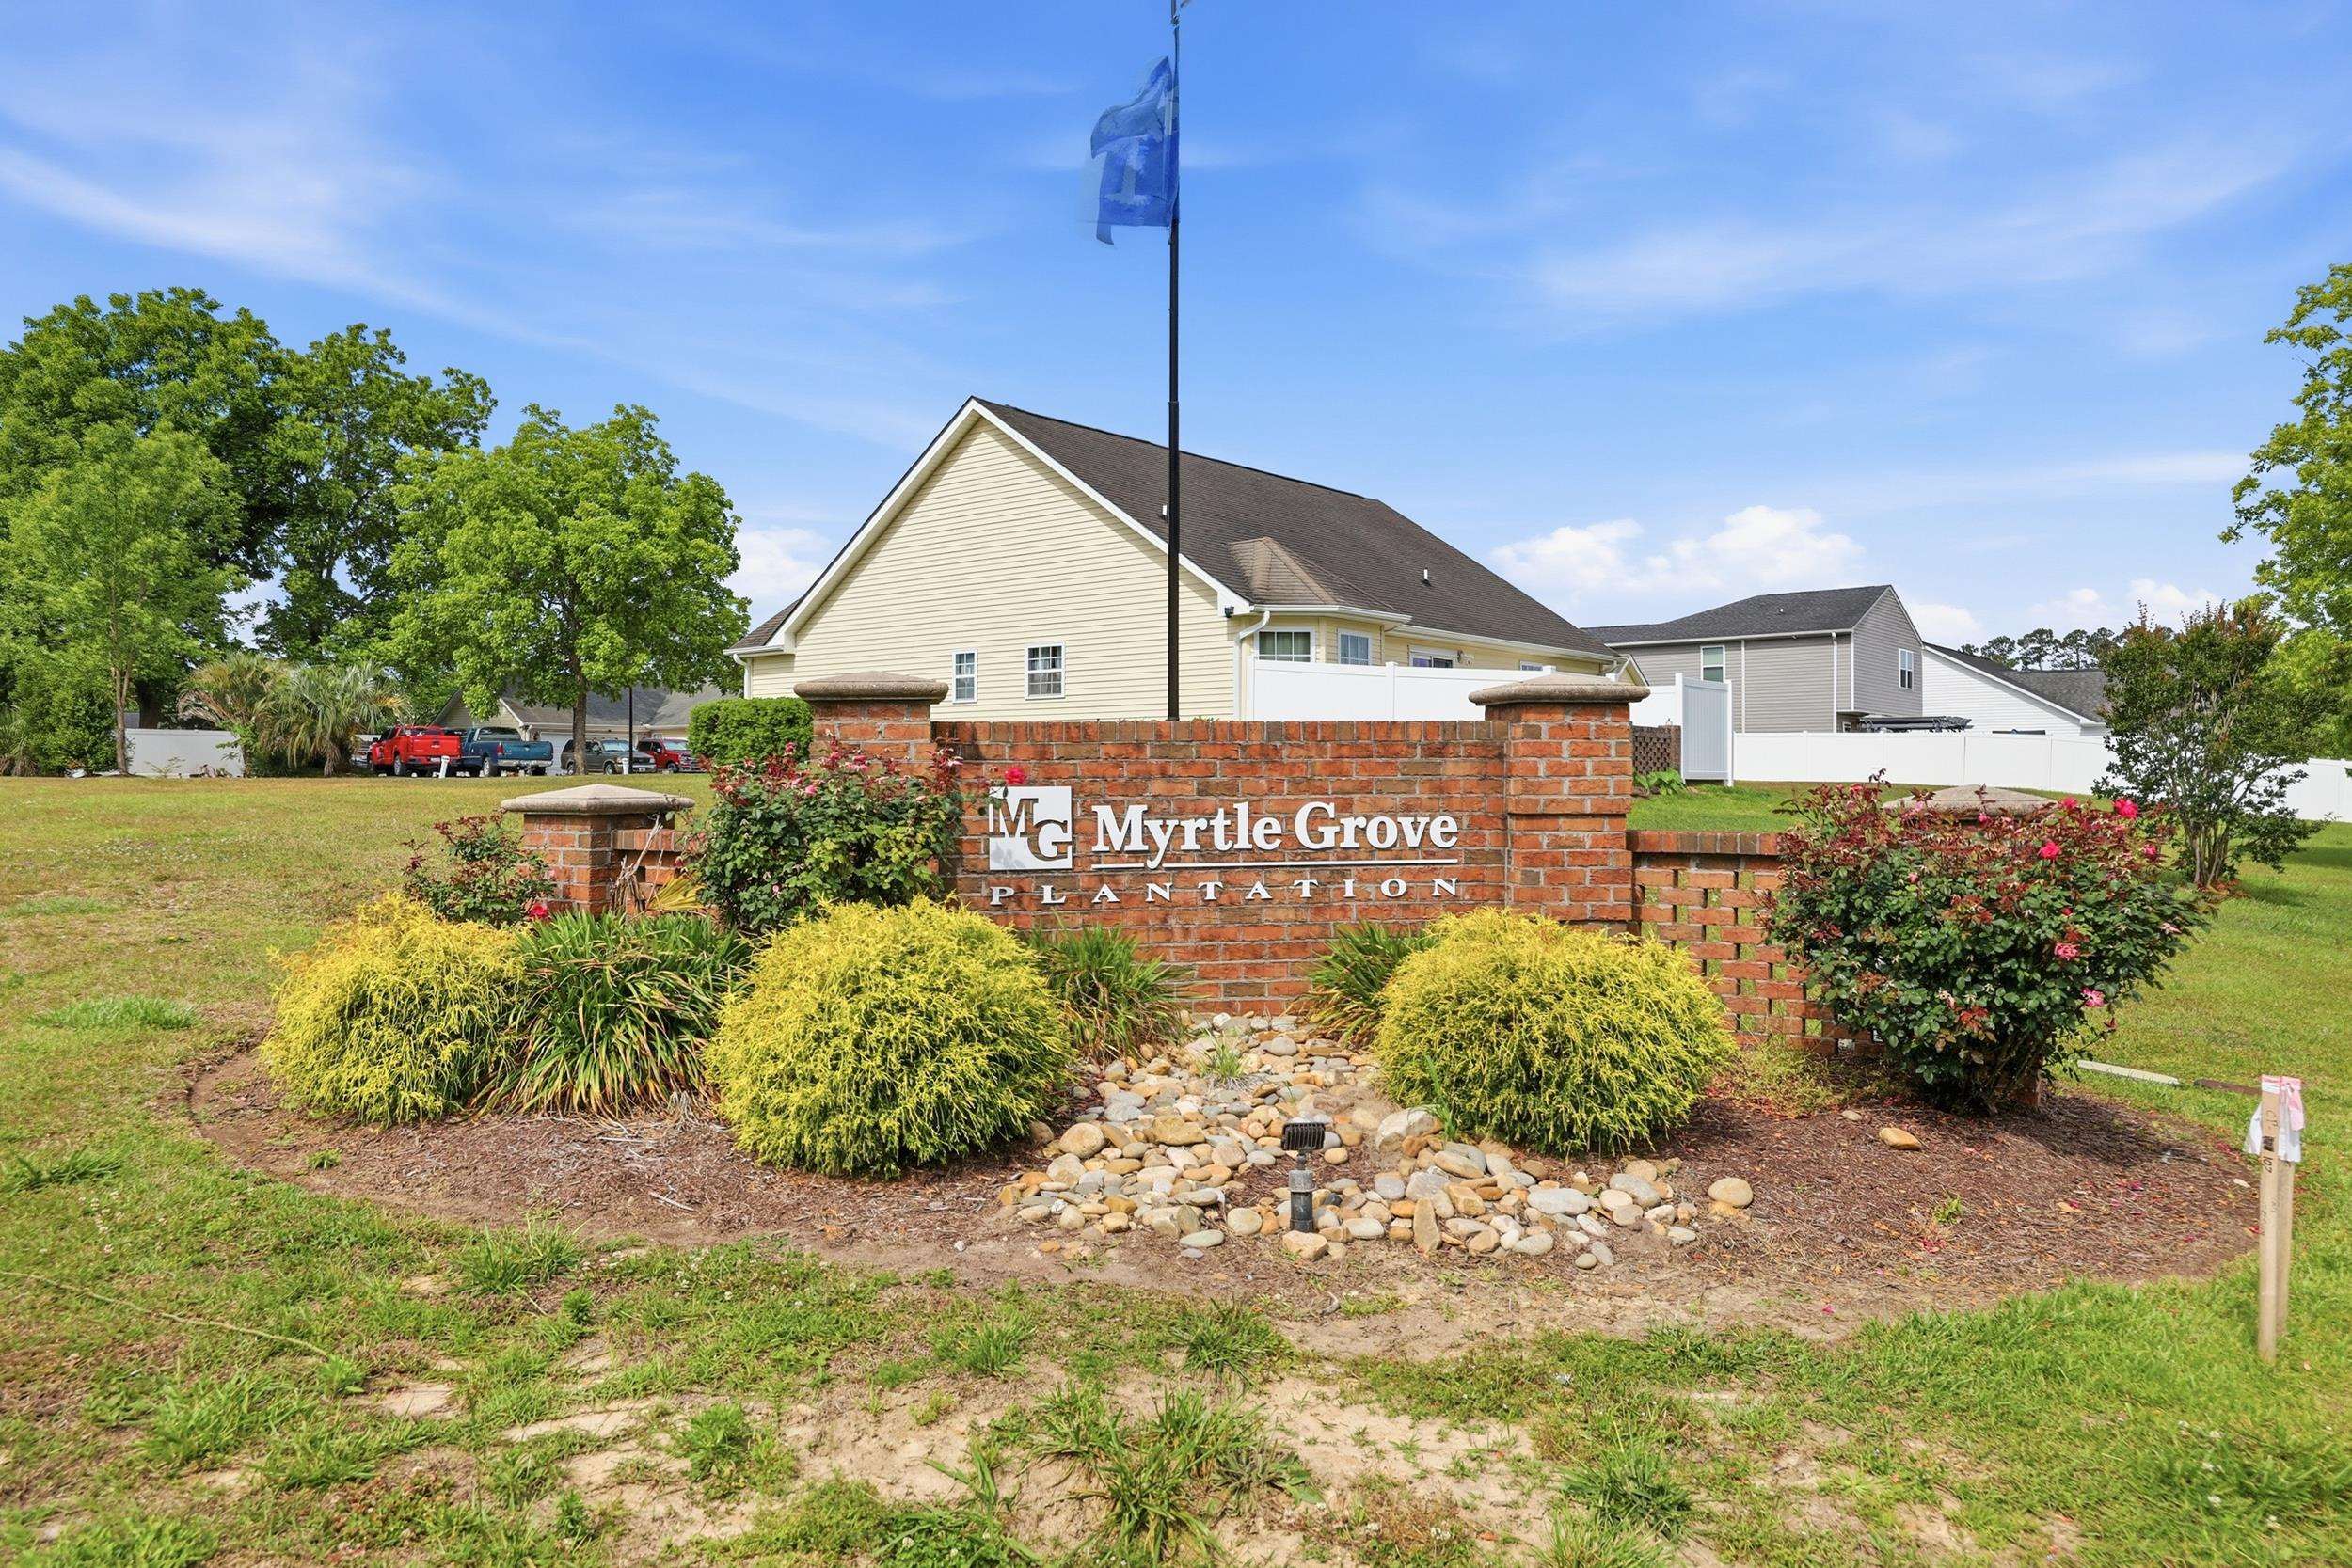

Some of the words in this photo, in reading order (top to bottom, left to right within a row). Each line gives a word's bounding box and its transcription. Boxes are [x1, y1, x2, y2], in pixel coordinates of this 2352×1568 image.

[1091, 801, 1282, 869] Myrtle
[1295, 801, 1458, 849] Grove
[990, 878, 1458, 905] PLANTATION
